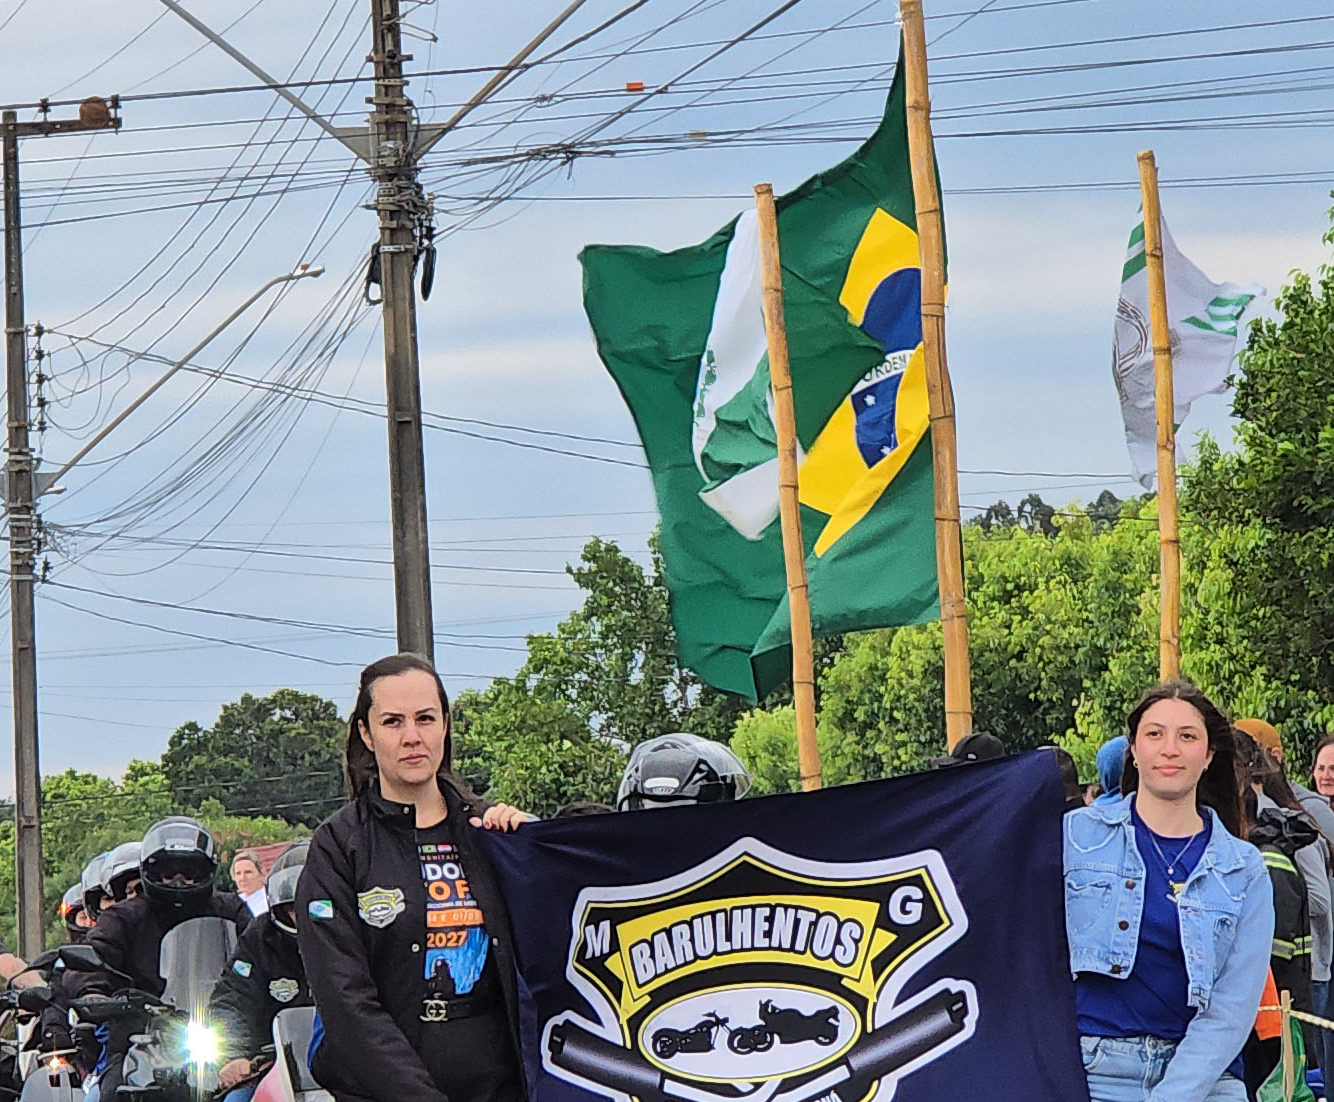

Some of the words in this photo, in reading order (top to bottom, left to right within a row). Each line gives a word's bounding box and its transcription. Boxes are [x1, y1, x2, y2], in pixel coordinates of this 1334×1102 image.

[423, 863, 464, 880] DO
[888, 885, 924, 925] G
[426, 931, 468, 948] 2027
[584, 919, 611, 960] M
[630, 905, 863, 985] BARULHENTOS
